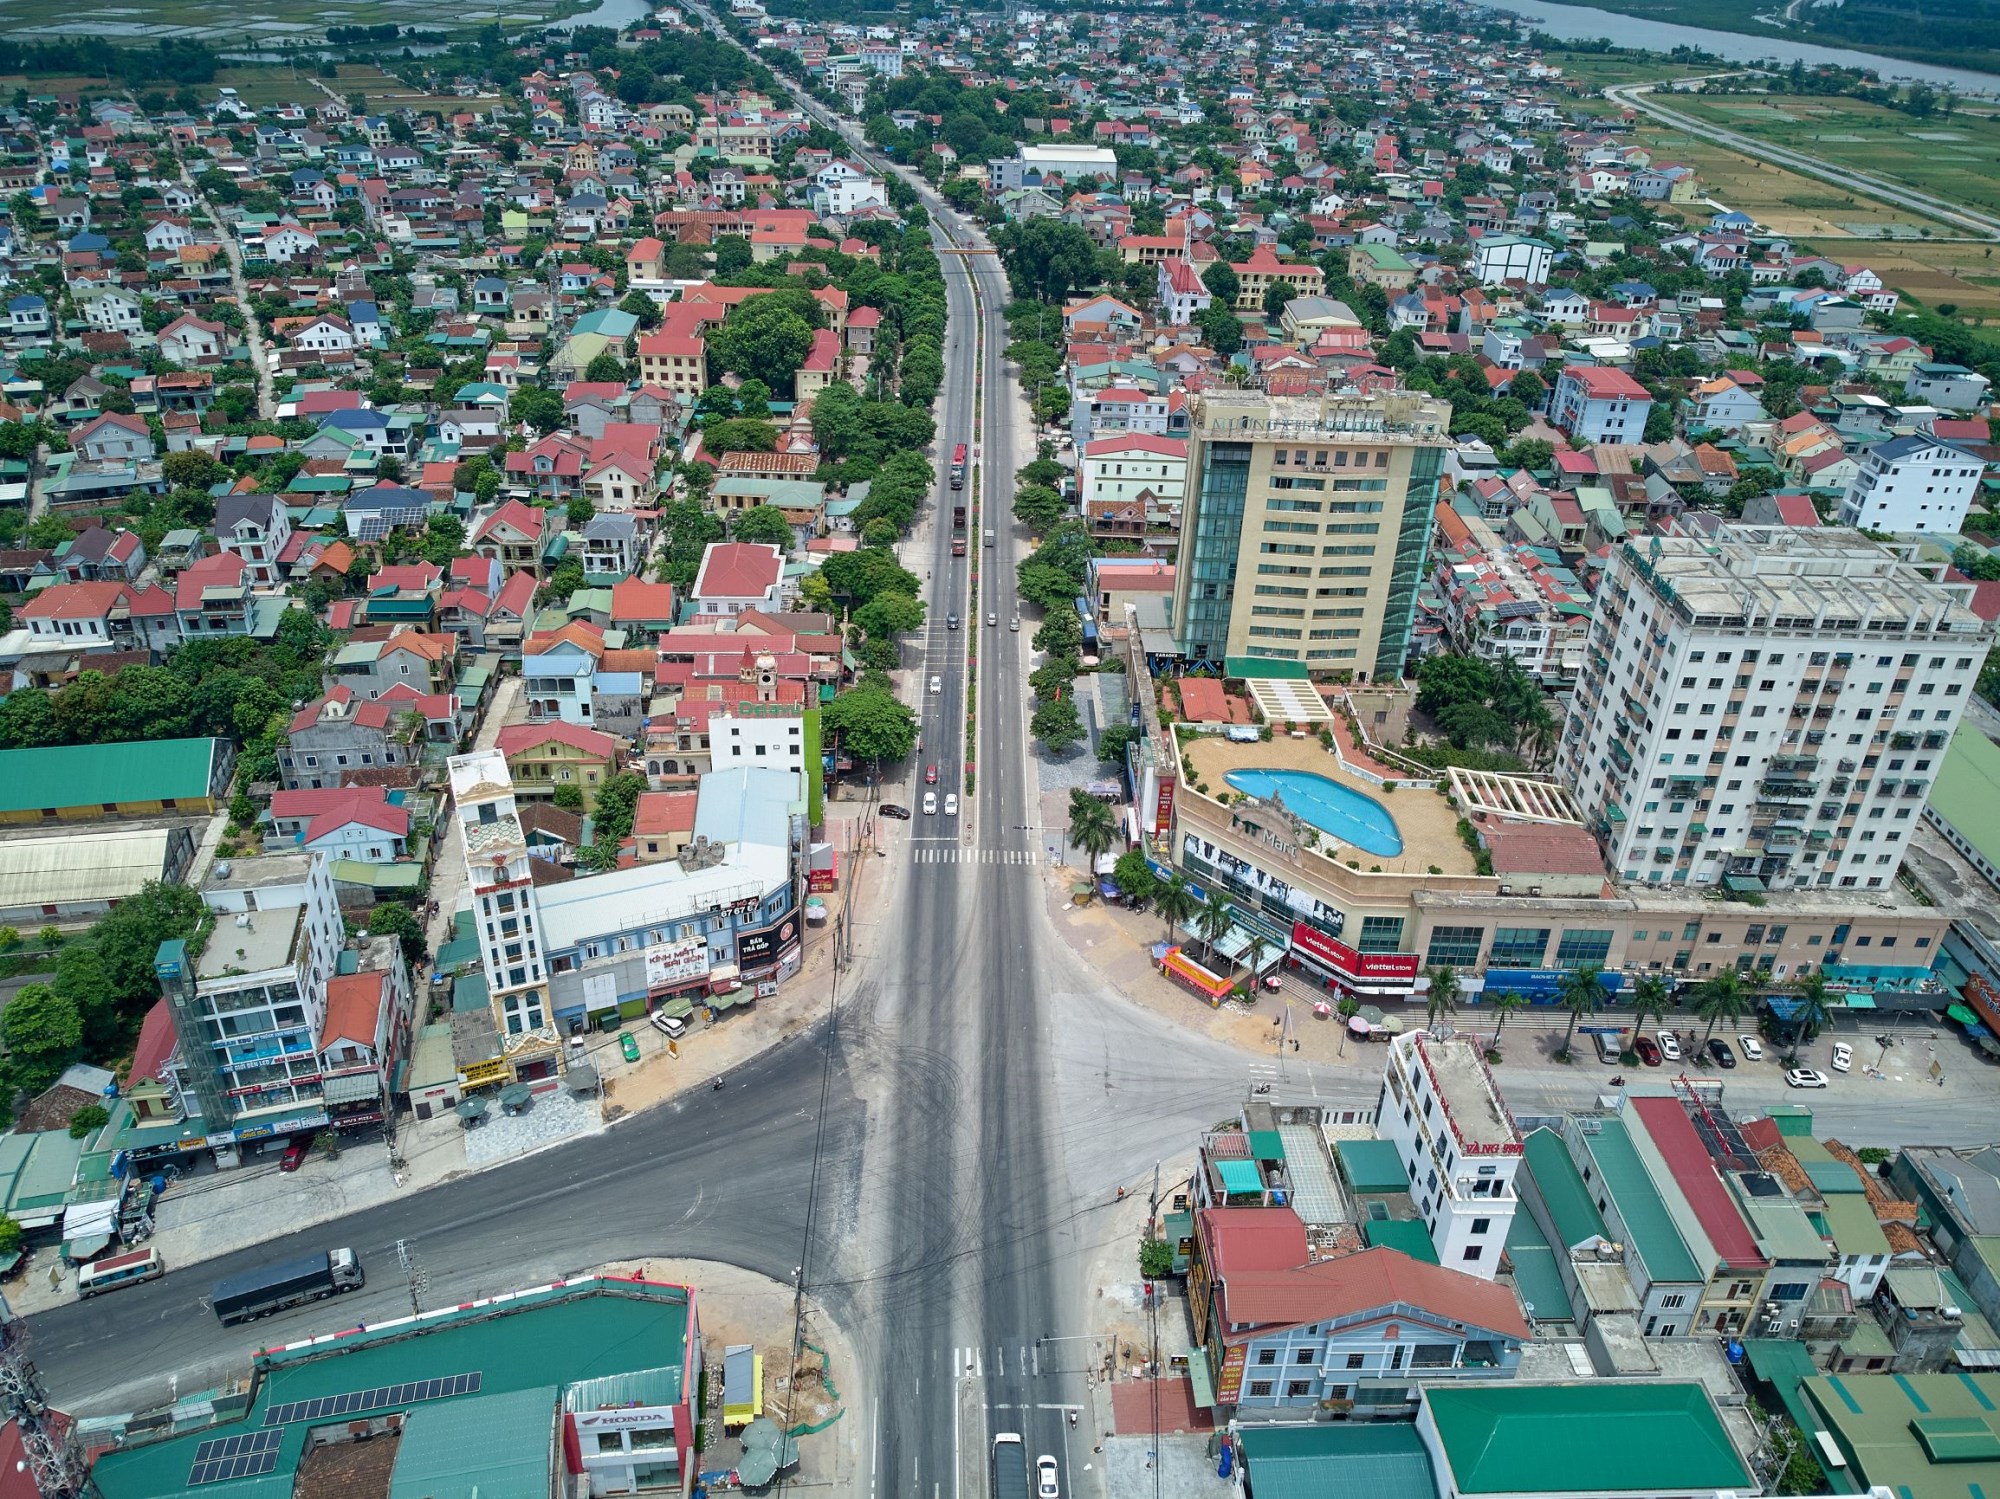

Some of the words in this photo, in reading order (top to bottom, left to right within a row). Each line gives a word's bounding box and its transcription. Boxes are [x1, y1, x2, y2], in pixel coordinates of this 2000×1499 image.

[1262, 829, 1297, 858] Mart
[1466, 1141, 1499, 1154] VÀNG
[1502, 1144, 1524, 1154] 9999
[601, 1414, 665, 1424] HONDA
